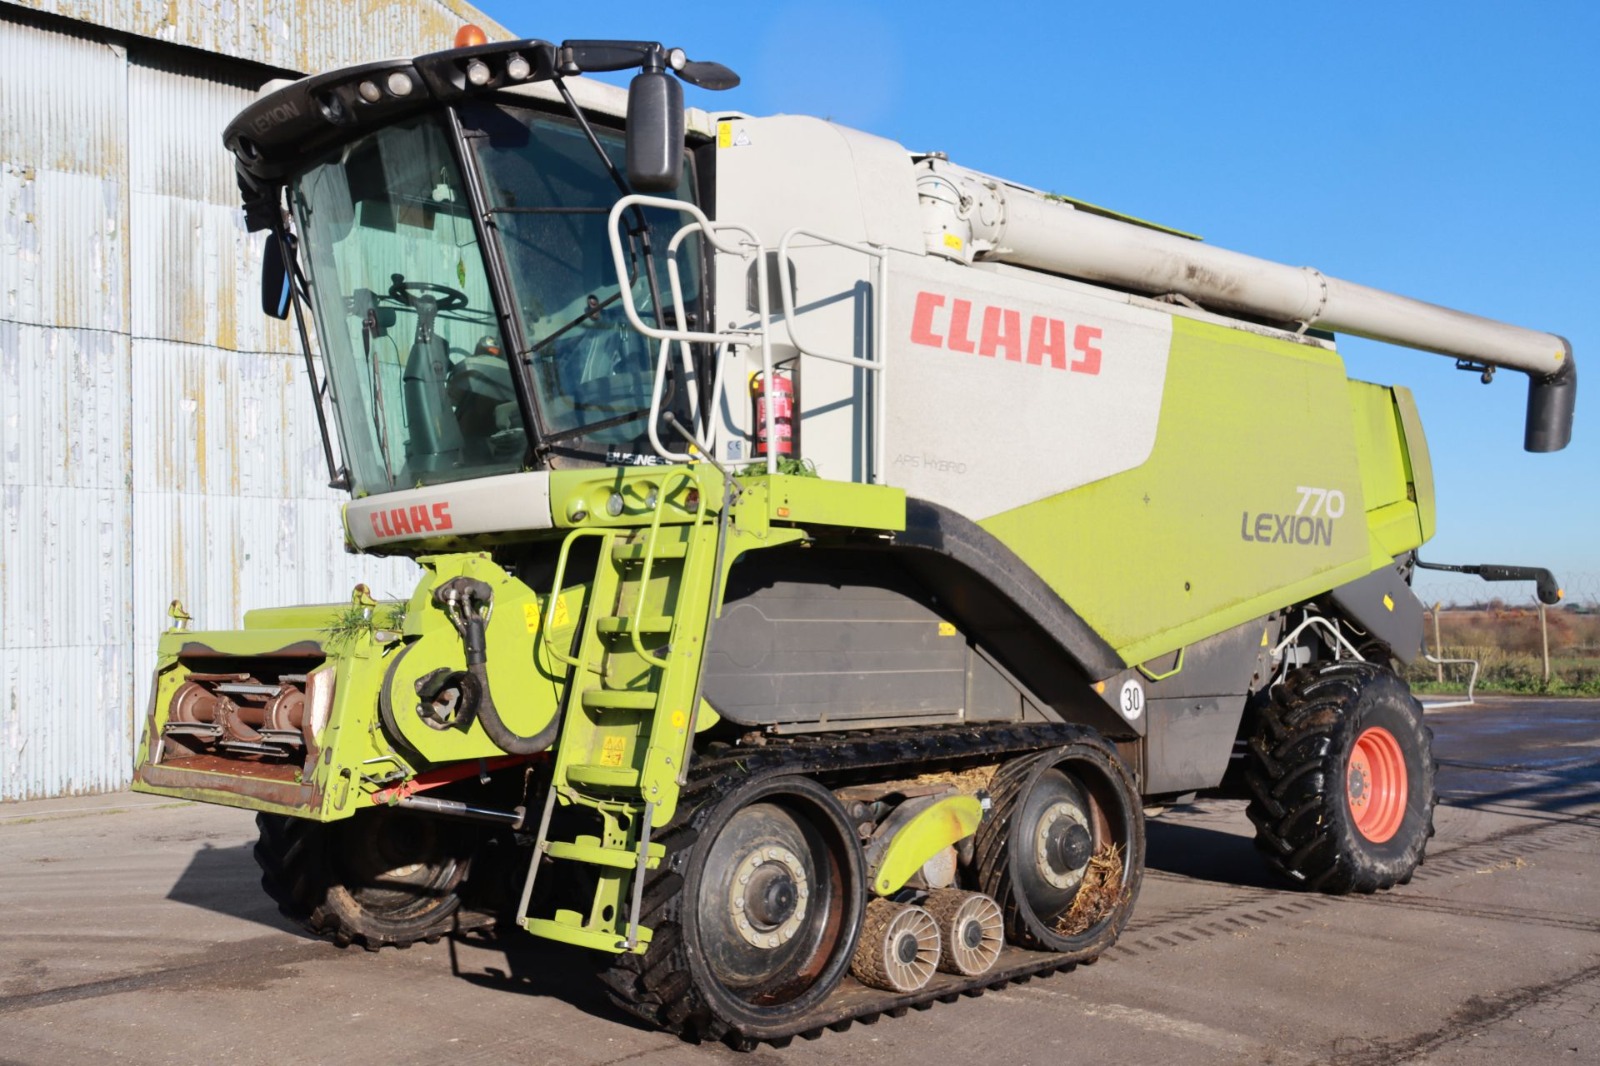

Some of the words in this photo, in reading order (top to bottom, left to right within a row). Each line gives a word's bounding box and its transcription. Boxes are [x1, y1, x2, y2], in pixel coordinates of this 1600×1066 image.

[910, 291, 1103, 376] CLAAS
[1295, 485, 1345, 519] 770
[370, 502, 453, 538] CLAAS
[1241, 511, 1333, 546] LEXION
[1125, 687, 1140, 712] 30
